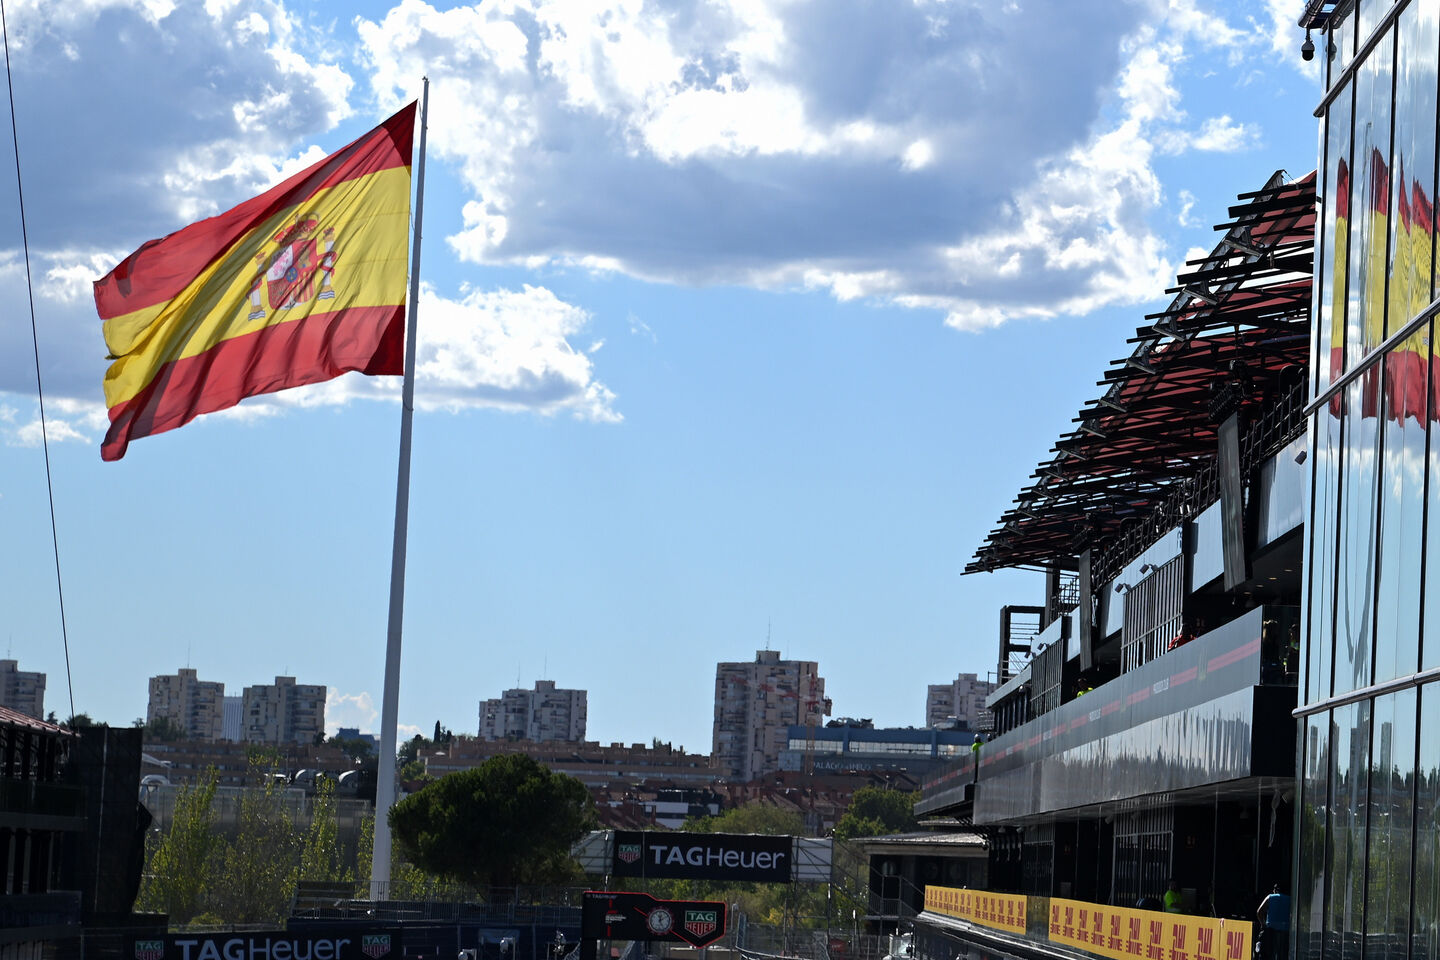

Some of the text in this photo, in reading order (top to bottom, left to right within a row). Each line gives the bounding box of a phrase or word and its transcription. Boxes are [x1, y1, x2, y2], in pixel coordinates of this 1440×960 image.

[688, 912, 714, 922] TAG
[686, 922, 714, 936] HEUER
[364, 936, 388, 945] TAG
[137, 942, 161, 950] TAG
